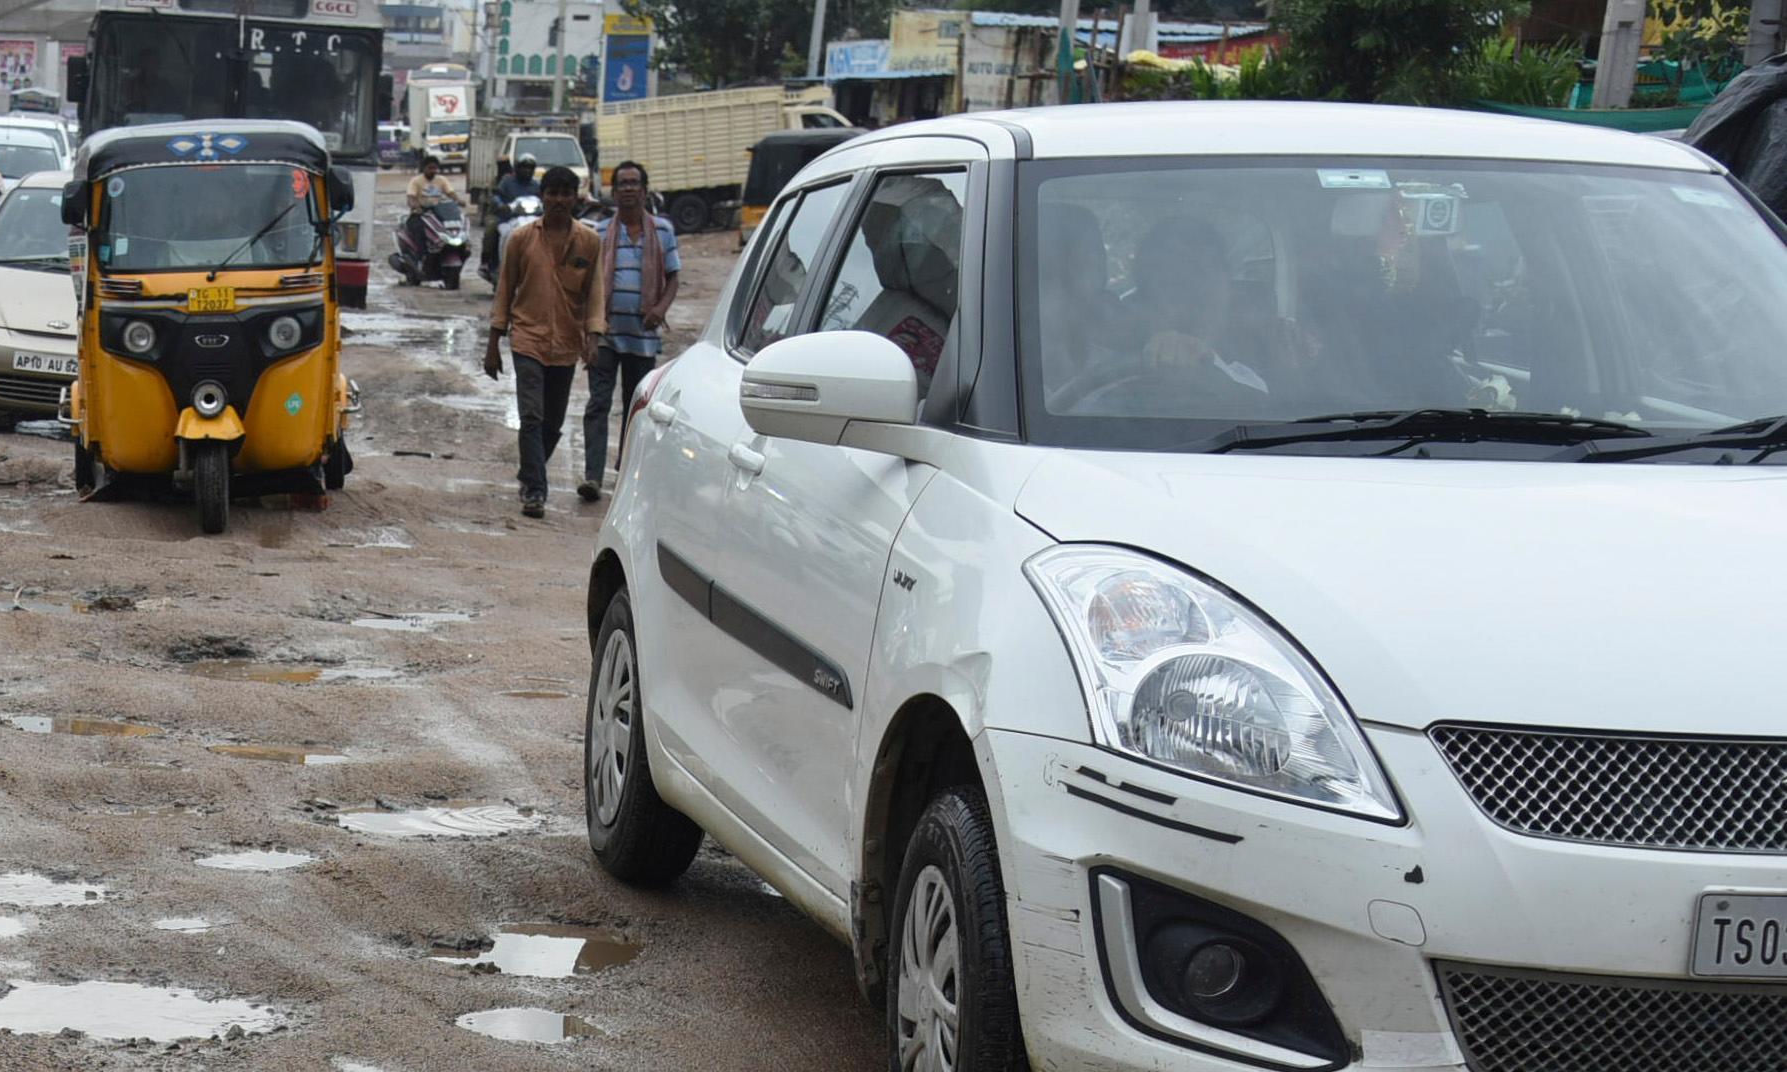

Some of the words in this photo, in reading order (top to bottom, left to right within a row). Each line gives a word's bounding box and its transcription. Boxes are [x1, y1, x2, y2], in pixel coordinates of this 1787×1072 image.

[967, 61, 993, 75] AUTO
[16, 355, 42, 369] AP10
[48, 359, 62, 371] AU
[814, 670, 843, 696] SWIFT
